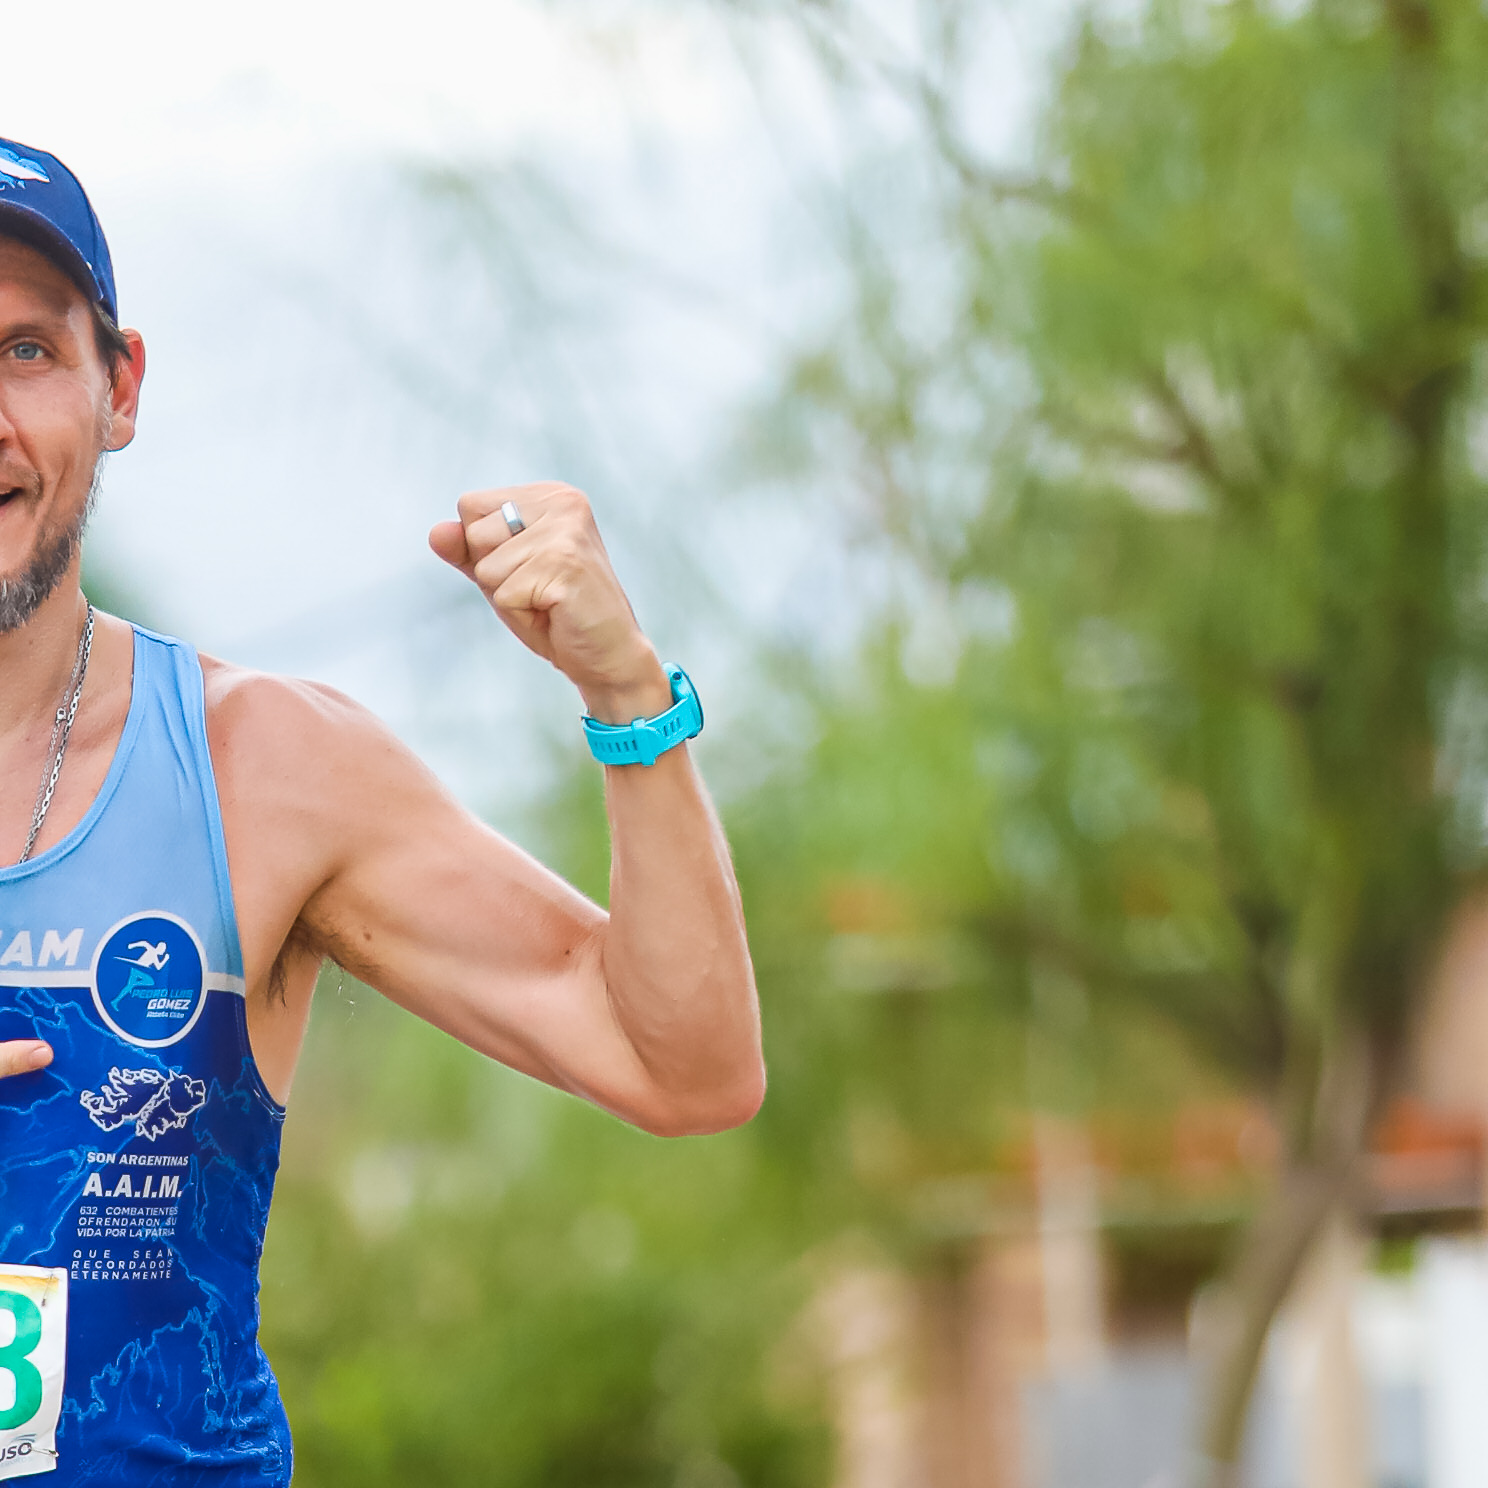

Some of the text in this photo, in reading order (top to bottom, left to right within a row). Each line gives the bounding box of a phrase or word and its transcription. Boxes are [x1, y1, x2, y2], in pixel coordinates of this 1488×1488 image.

[131, 988, 194, 998] PEDRO LUIS
[147, 998, 191, 1010] GOMEZ
[87, 1152, 189, 1166] SON ARGENTINAS
[82, 1172, 183, 1198] A.A.I.M.
[79, 1206, 179, 1215] 632 COMBATIENTES
[78, 1217, 177, 1226] OFRENDARON SU
[77, 1228, 175, 1237] VIDA POR LA PATRIA
[73, 1248, 173, 1259] QUE SEAN
[71, 1258, 173, 1270] RECORDADOS
[71, 1270, 172, 1280] ETERNAMENTE
